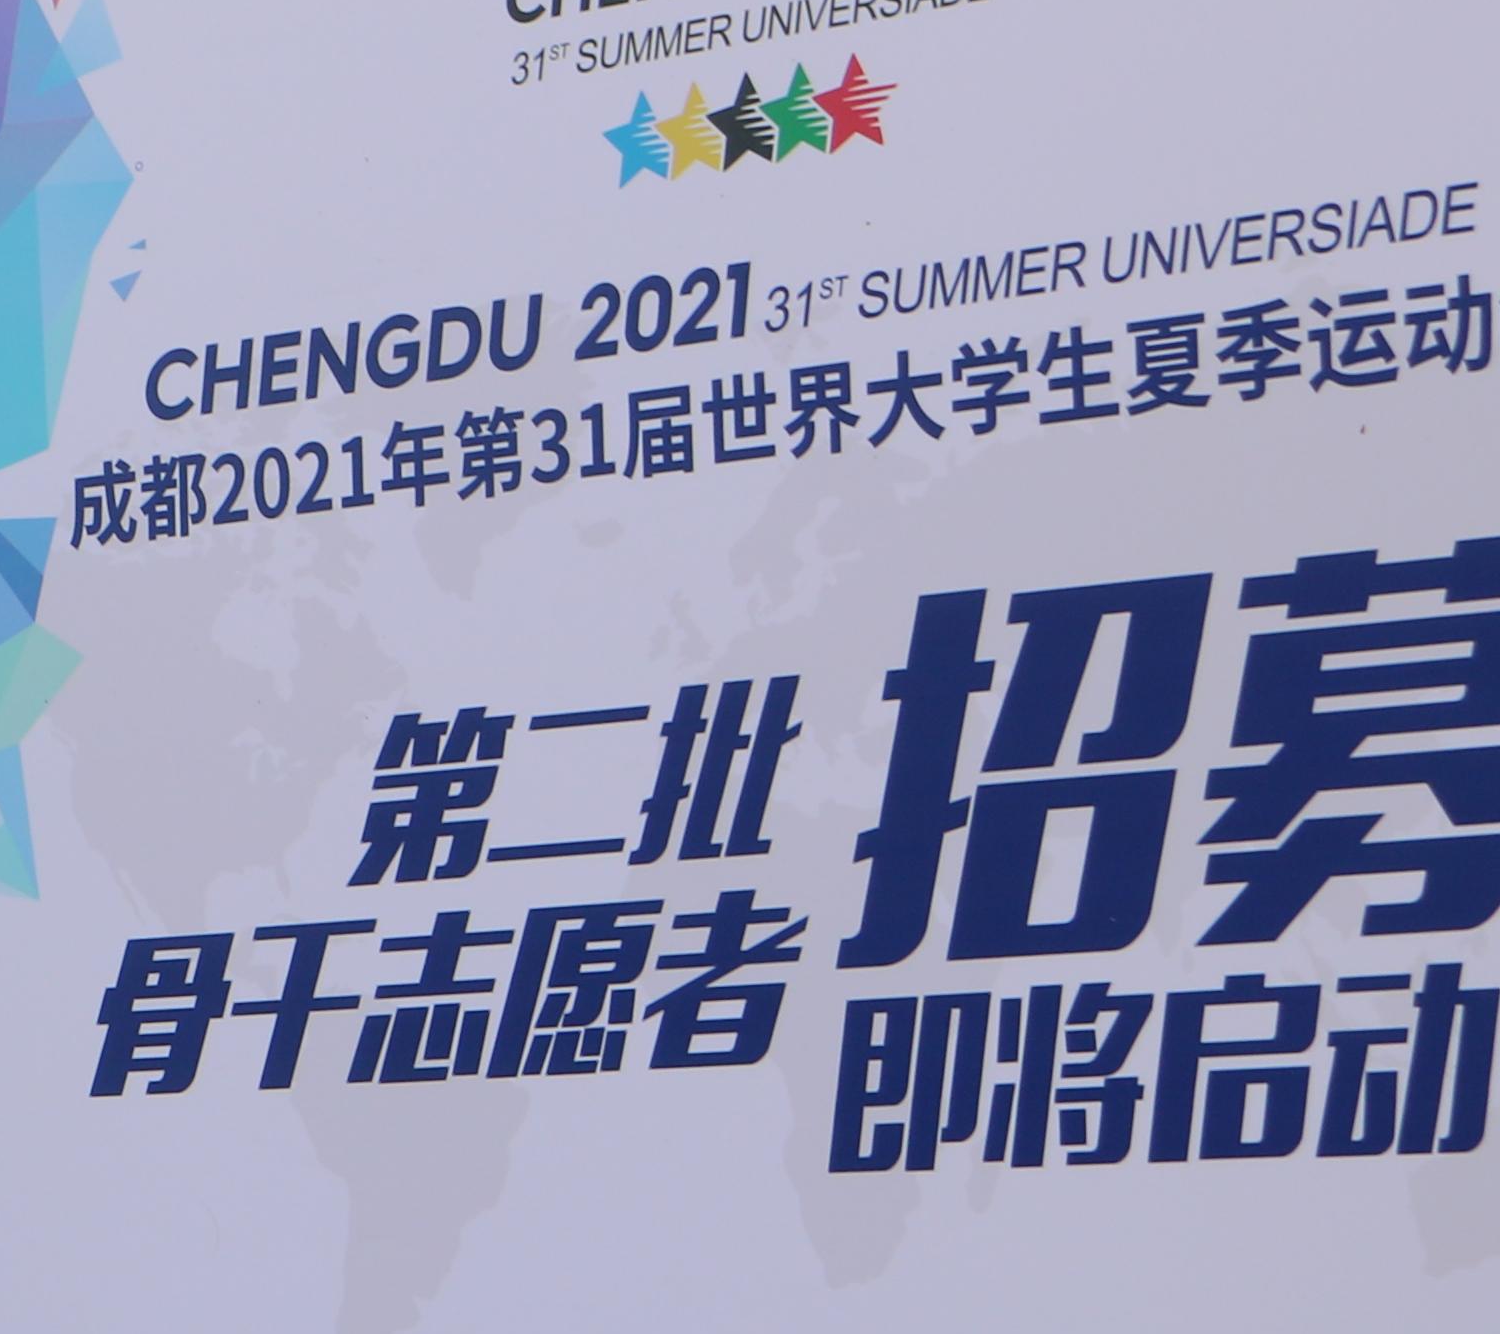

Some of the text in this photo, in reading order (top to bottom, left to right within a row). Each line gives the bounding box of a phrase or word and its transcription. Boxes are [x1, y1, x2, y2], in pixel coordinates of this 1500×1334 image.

[575, 13, 733, 74] SUMMER
[144, 292, 544, 423] CHENGDU
[572, 261, 753, 362] 2021
[857, 239, 1087, 321] SUMMER
[1100, 182, 1480, 287] UNIVERSIADE
[346, 673, 803, 887] 第二批
[835, 535, 1500, 970] 招募
[88, 887, 808, 1098] 骨干志愿者
[826, 961, 1498, 1174] 即将启动
